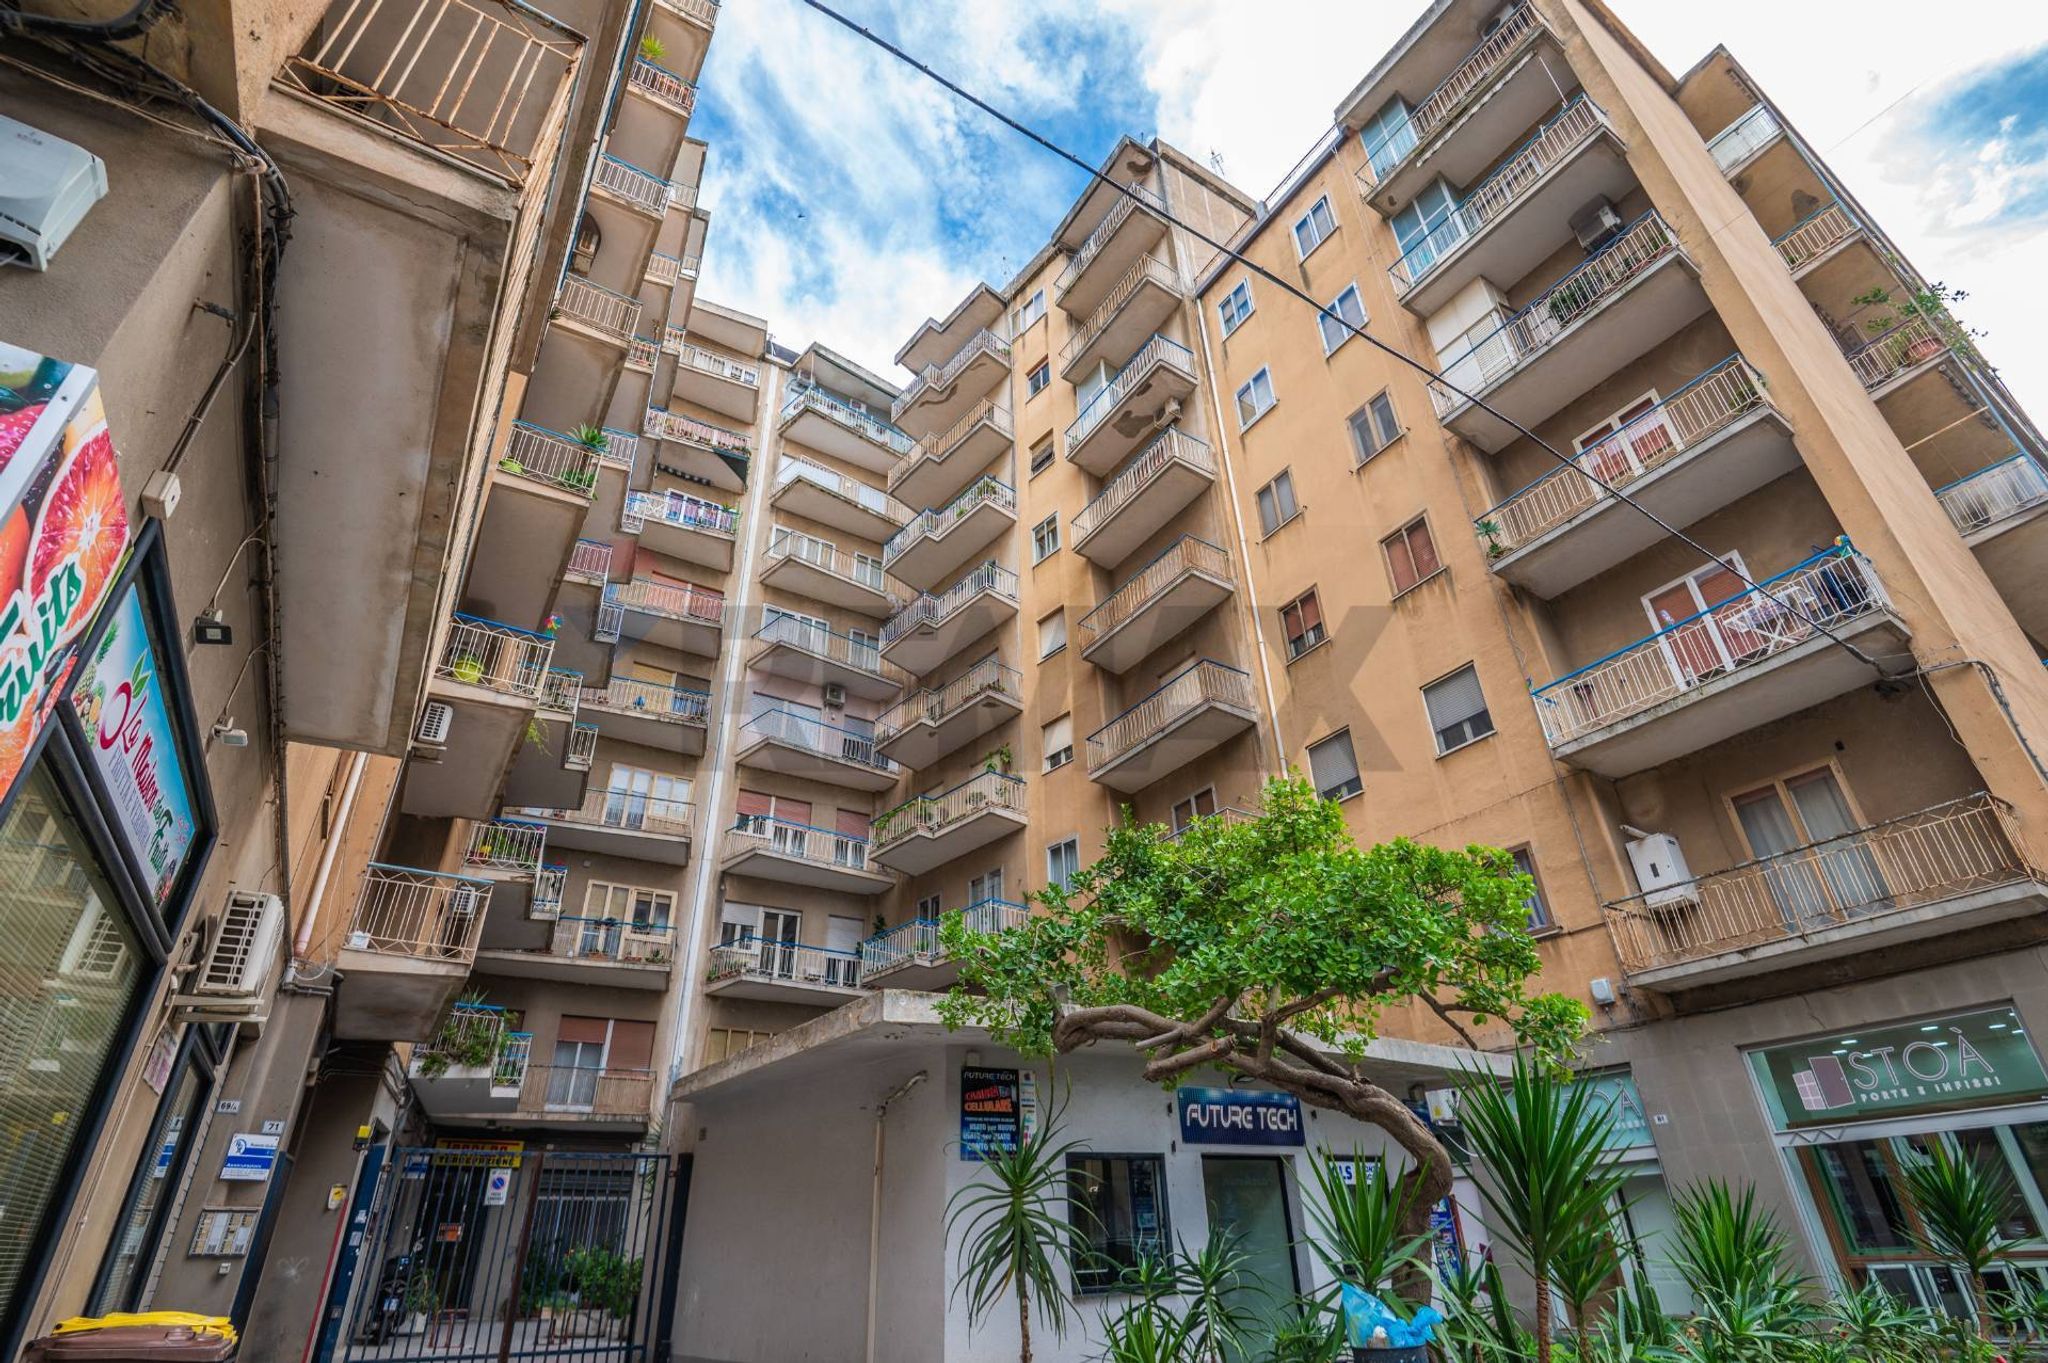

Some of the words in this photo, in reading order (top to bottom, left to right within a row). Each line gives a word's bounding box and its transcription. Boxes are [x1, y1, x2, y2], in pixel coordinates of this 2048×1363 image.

[1848, 1026, 1994, 1090] STOÀ
[1860, 1085, 1909, 1103] PORTE
[1934, 1075, 2001, 1094] INFISSI
[1186, 1103, 1253, 1129] FUTURE
[1257, 1106, 1298, 1131] TECH
